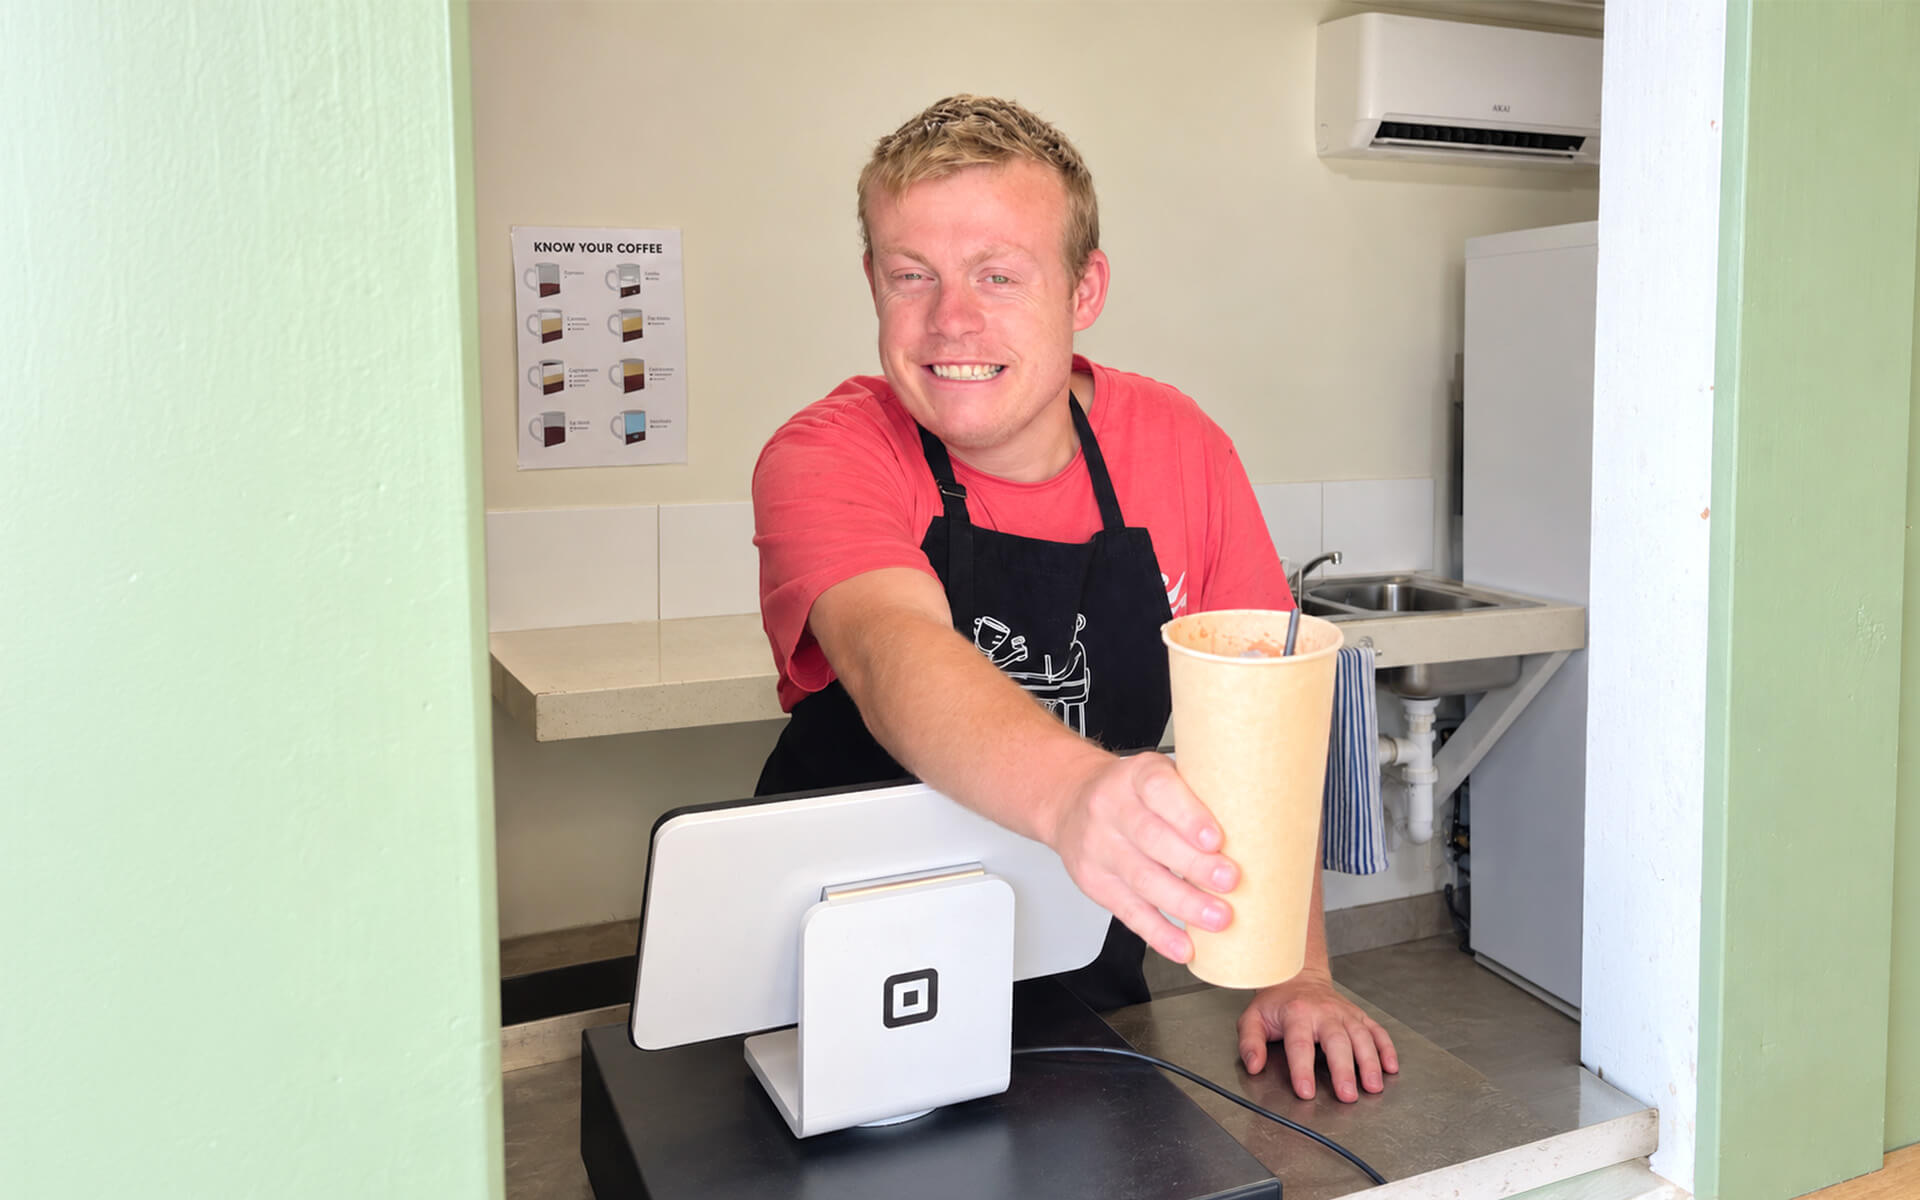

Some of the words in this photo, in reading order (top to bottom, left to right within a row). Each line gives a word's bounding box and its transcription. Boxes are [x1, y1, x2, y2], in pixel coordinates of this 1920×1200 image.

[1492, 103, 1511, 113] AKAI
[534, 242, 575, 252] KNOW
[579, 242, 613, 253] YOUR
[617, 243, 663, 253] COFFEE
